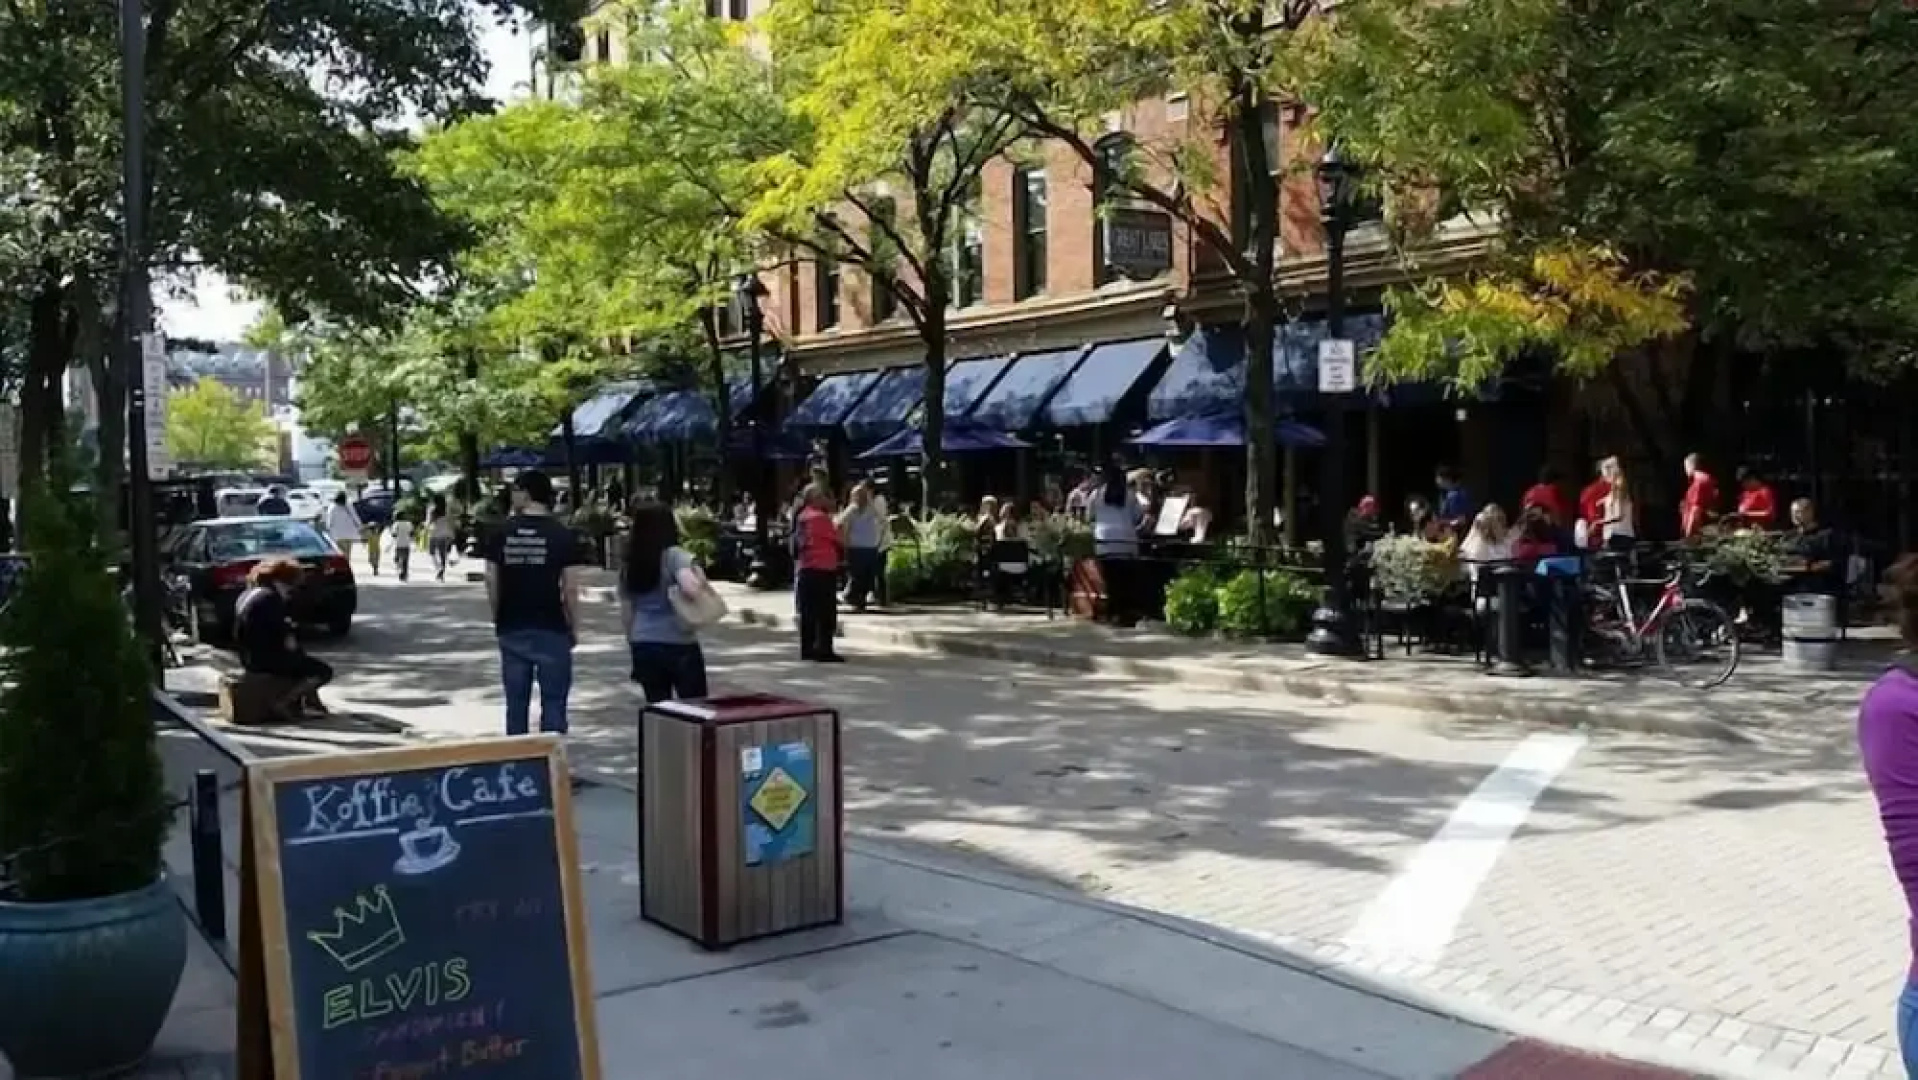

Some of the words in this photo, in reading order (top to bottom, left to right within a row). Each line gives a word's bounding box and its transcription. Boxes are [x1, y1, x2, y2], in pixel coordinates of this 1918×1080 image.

[342, 448, 370, 462] STOP
[303, 777, 422, 833] Koffie
[440, 763, 539, 811] Cafe
[322, 957, 471, 1029] ELVIS
